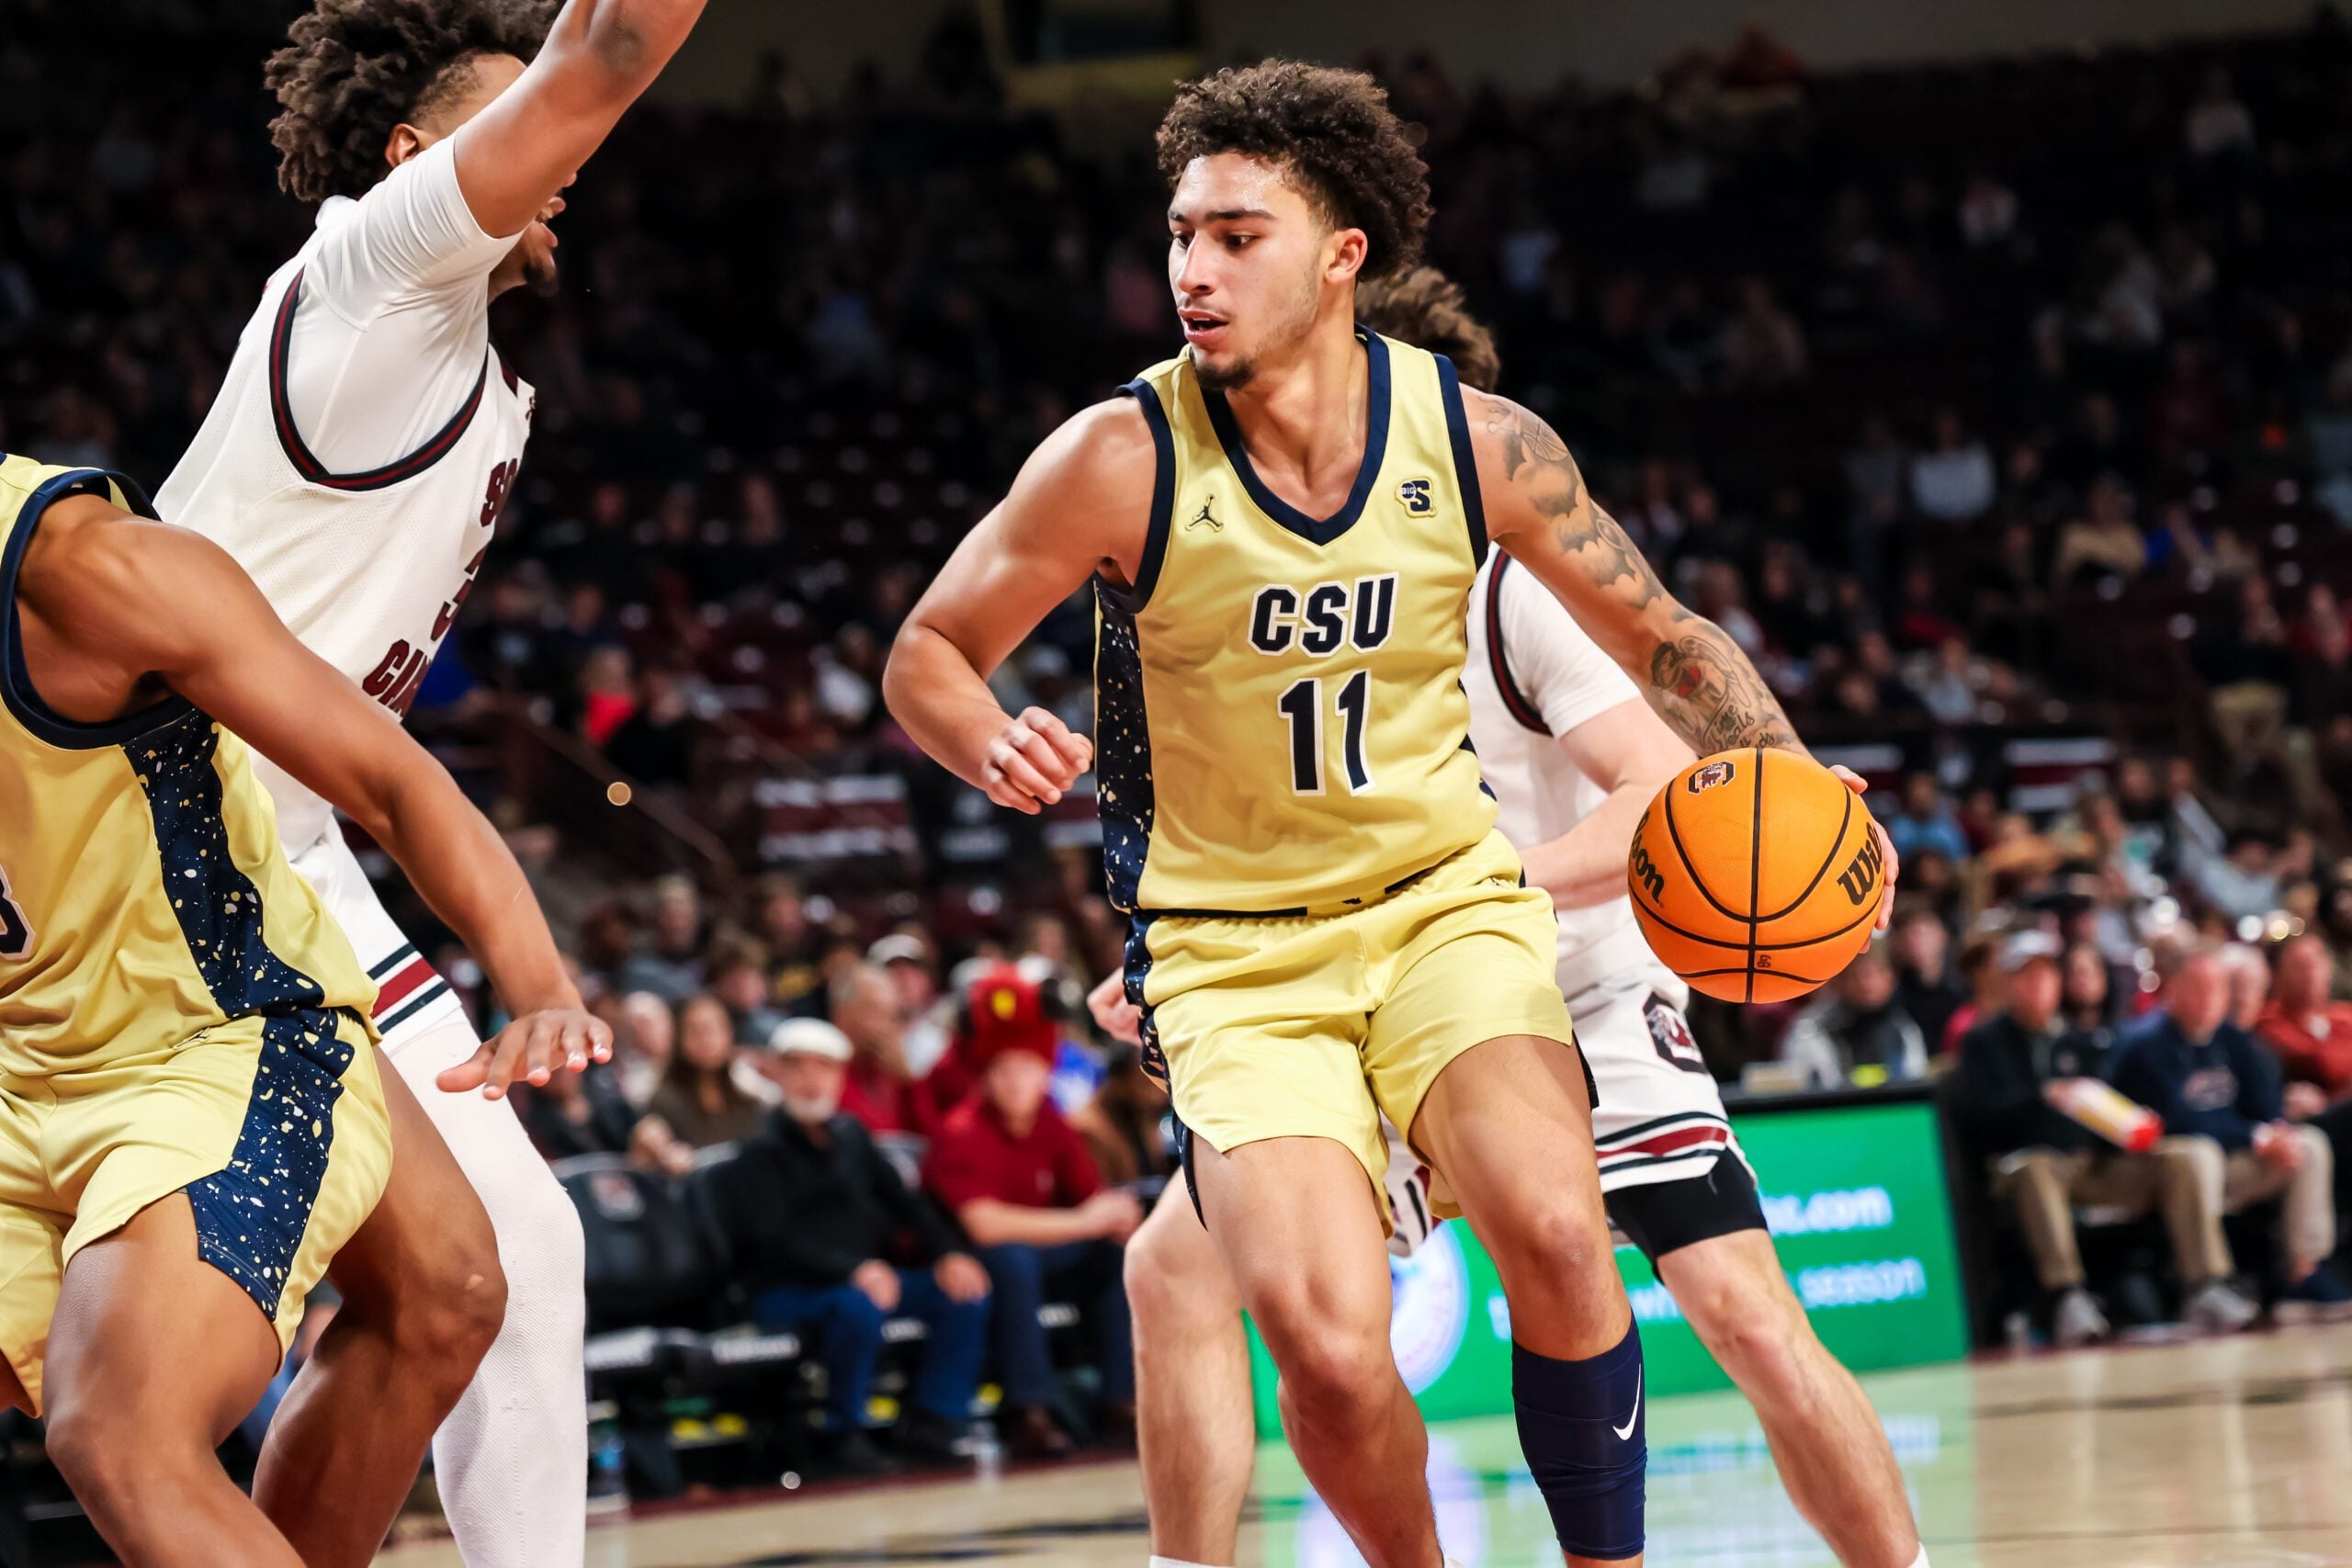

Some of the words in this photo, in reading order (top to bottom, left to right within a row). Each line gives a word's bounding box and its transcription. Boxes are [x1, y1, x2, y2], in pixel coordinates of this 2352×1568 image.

[1248, 572, 1398, 657] CSU
[1277, 668, 1375, 796] 11
[1837, 821, 1883, 906] Wil
